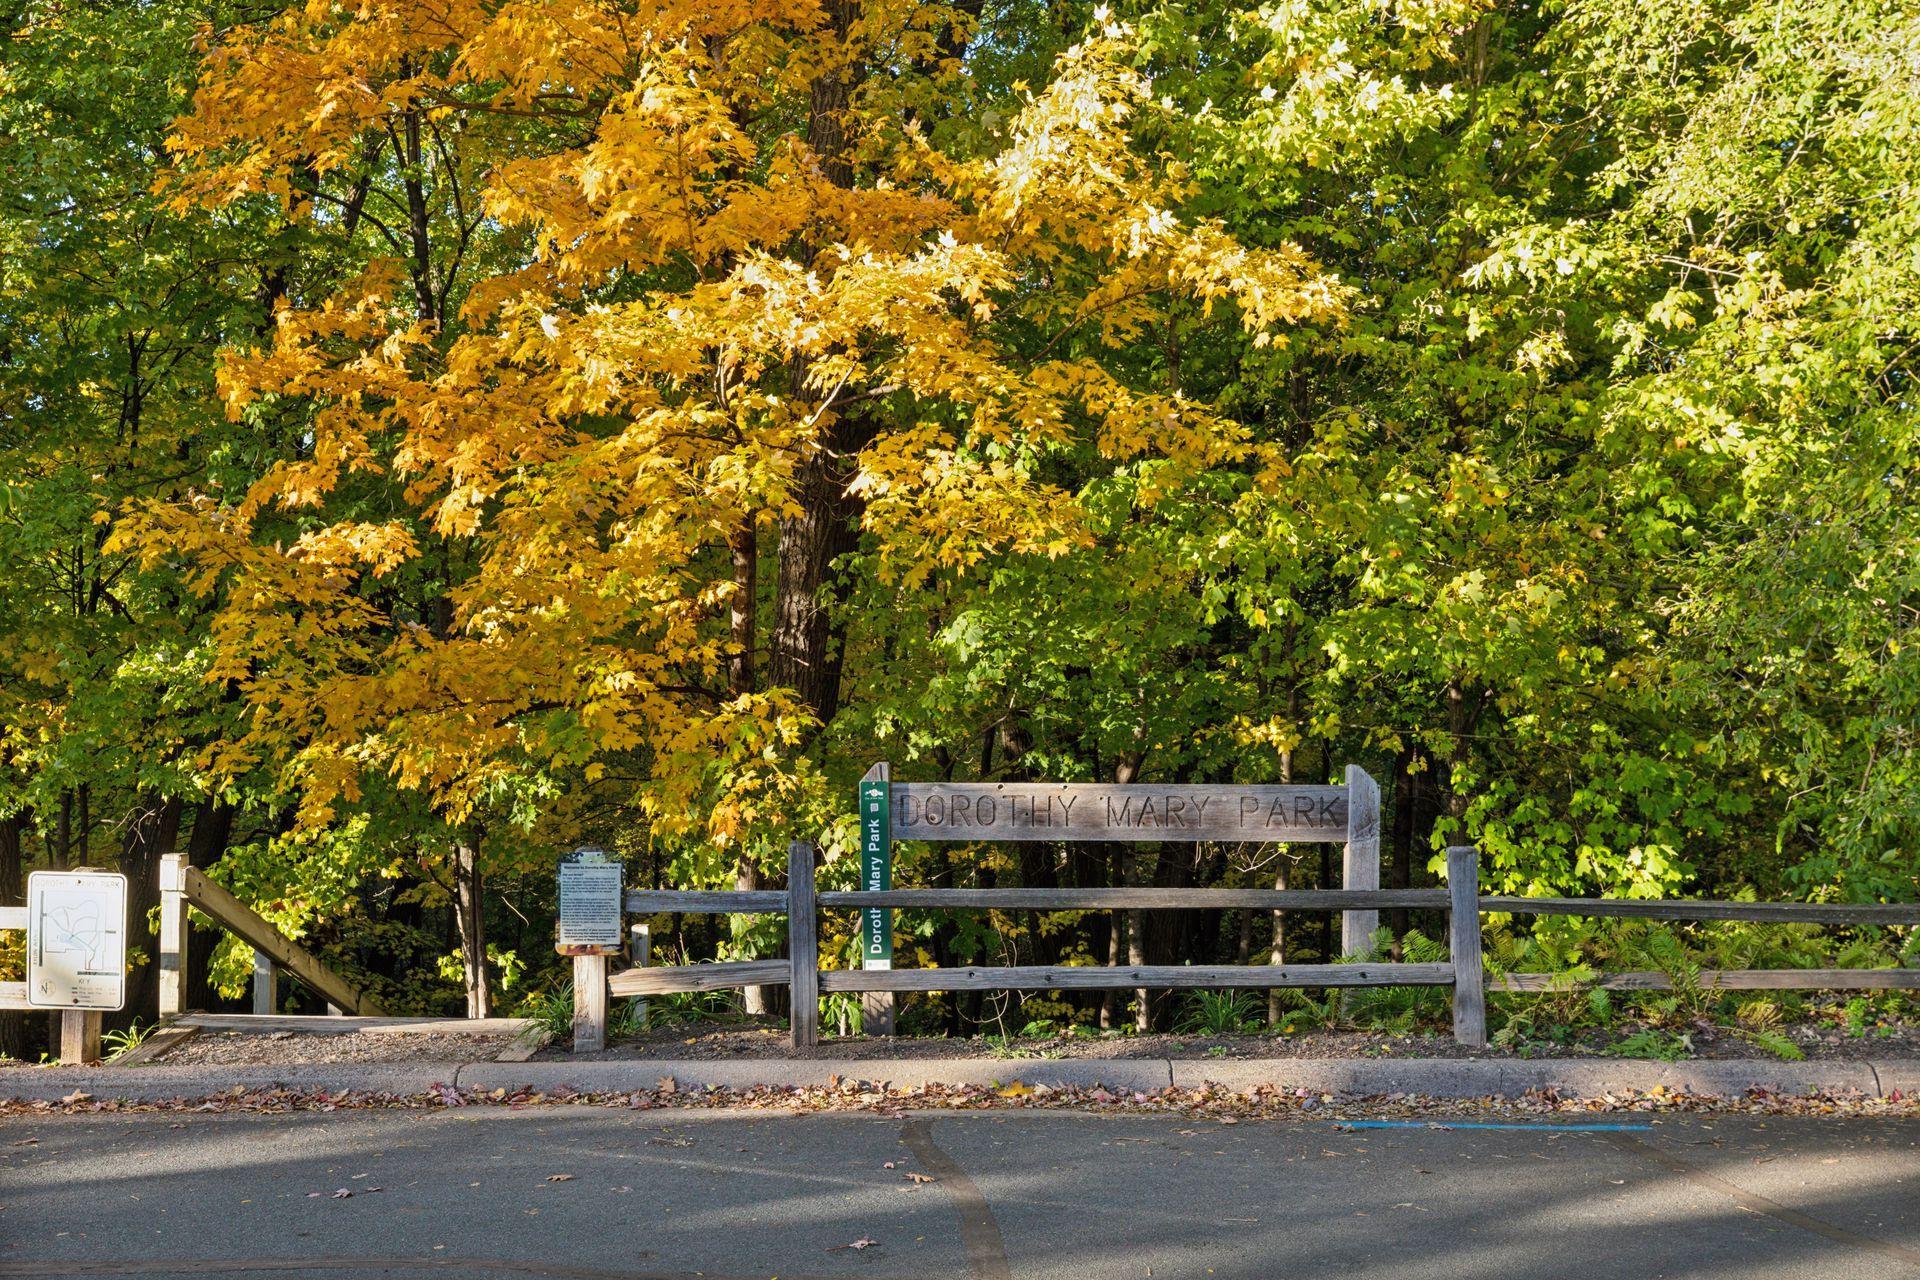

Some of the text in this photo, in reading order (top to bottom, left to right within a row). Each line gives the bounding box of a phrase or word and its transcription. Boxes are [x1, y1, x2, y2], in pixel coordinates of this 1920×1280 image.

[899, 794, 1343, 829] DOROTHY MARY PARK
[868, 819, 883, 954] Doroth Mary Park
